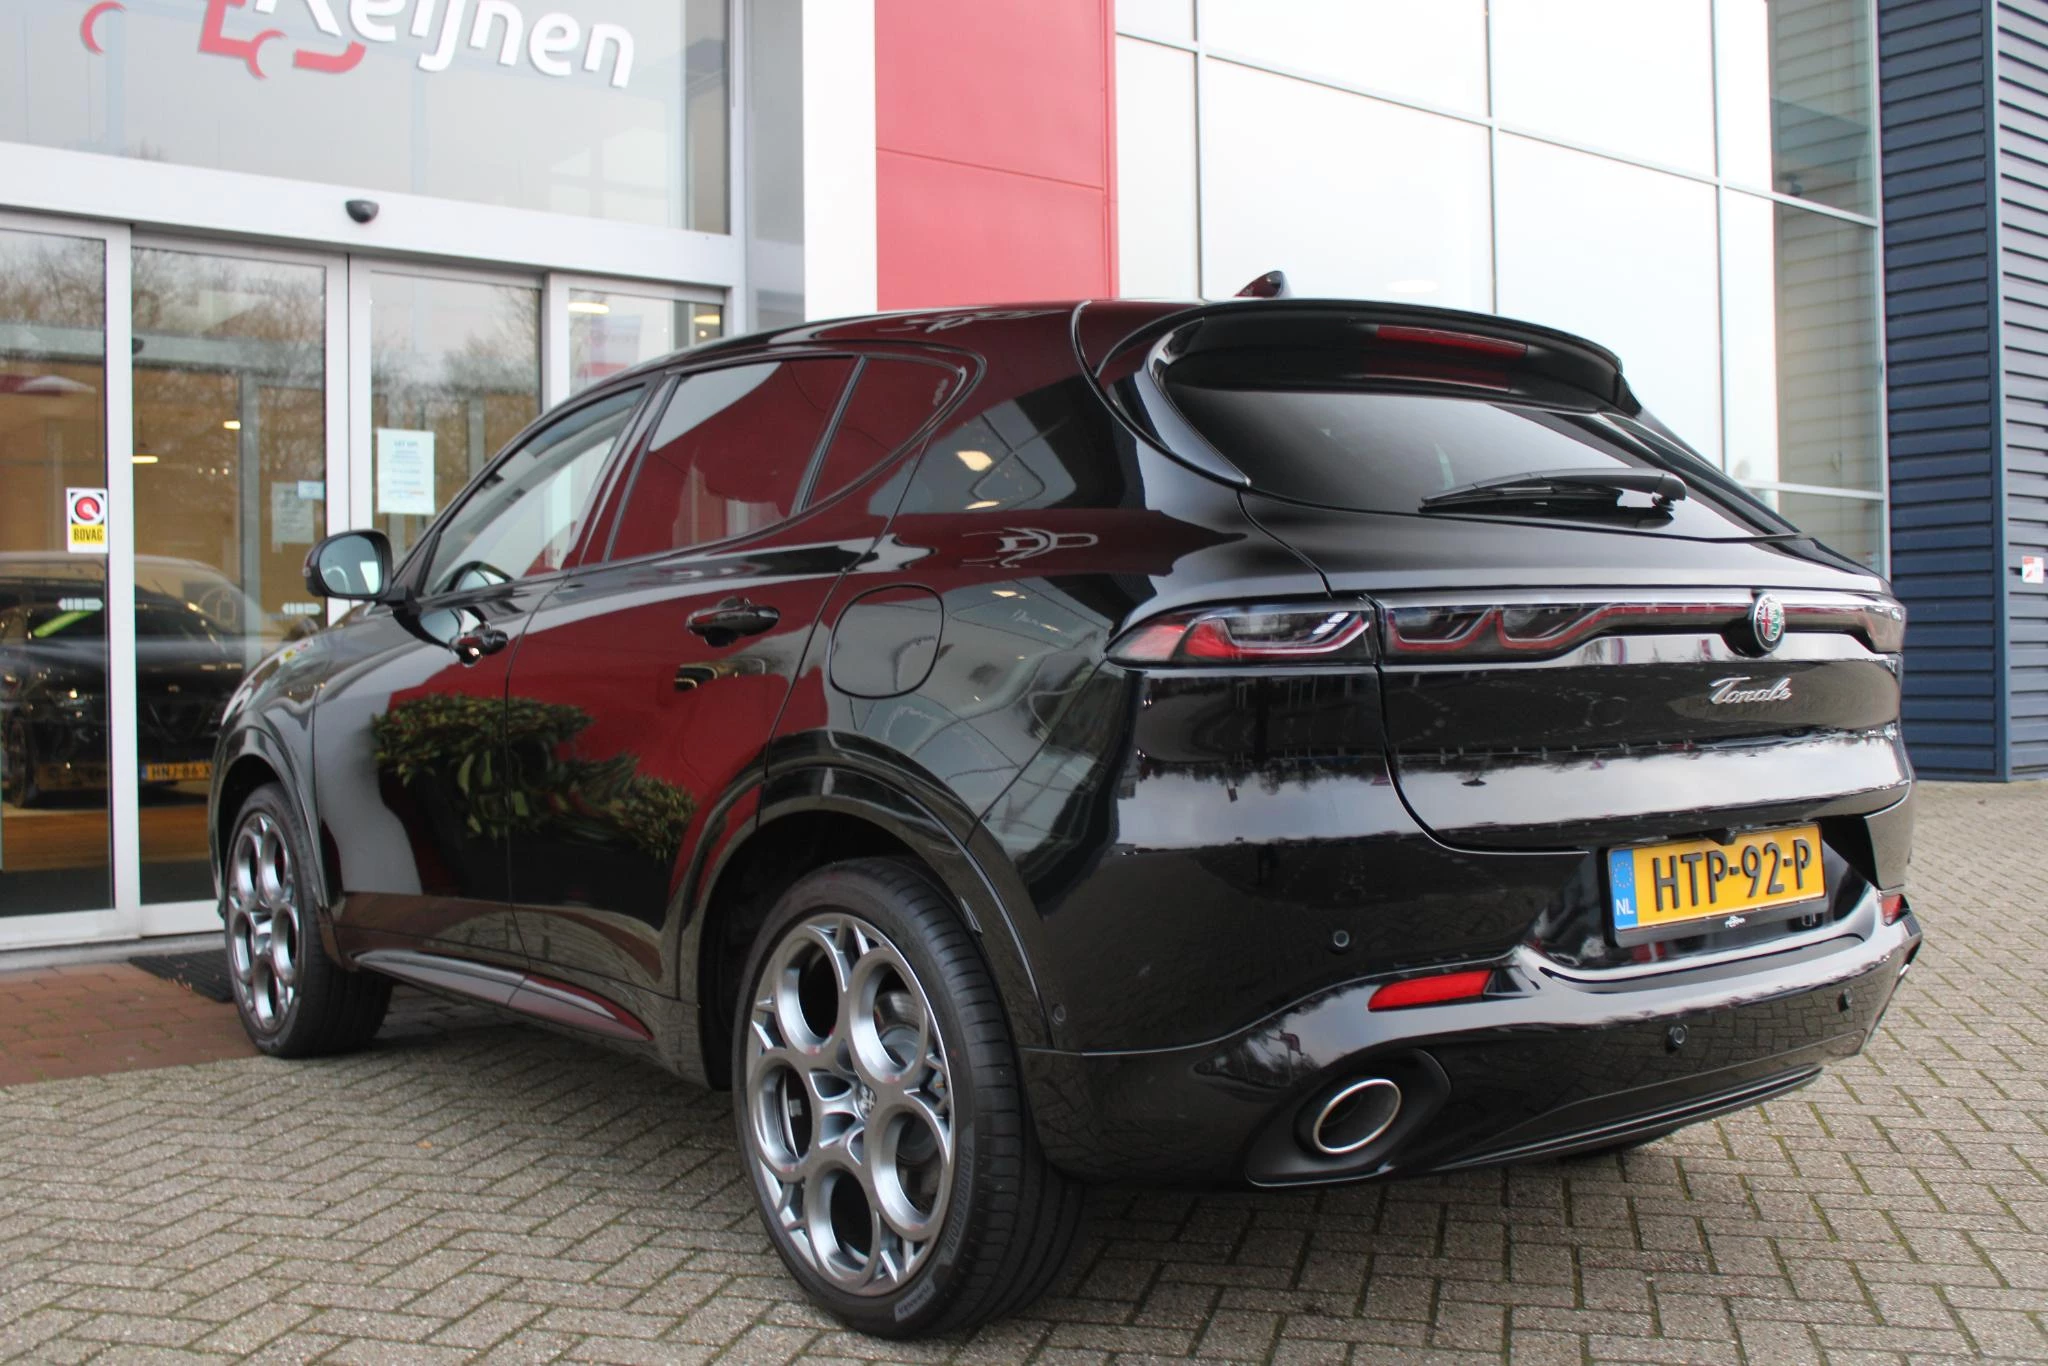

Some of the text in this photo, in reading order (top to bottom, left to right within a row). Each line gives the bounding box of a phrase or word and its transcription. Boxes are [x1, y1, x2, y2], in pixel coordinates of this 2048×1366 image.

[73, 527, 103, 541] BOVAG
[1709, 676, 1792, 705] Tonale
[1653, 838, 1812, 912] HTP-92-P
[1615, 898, 1635, 915] NL
